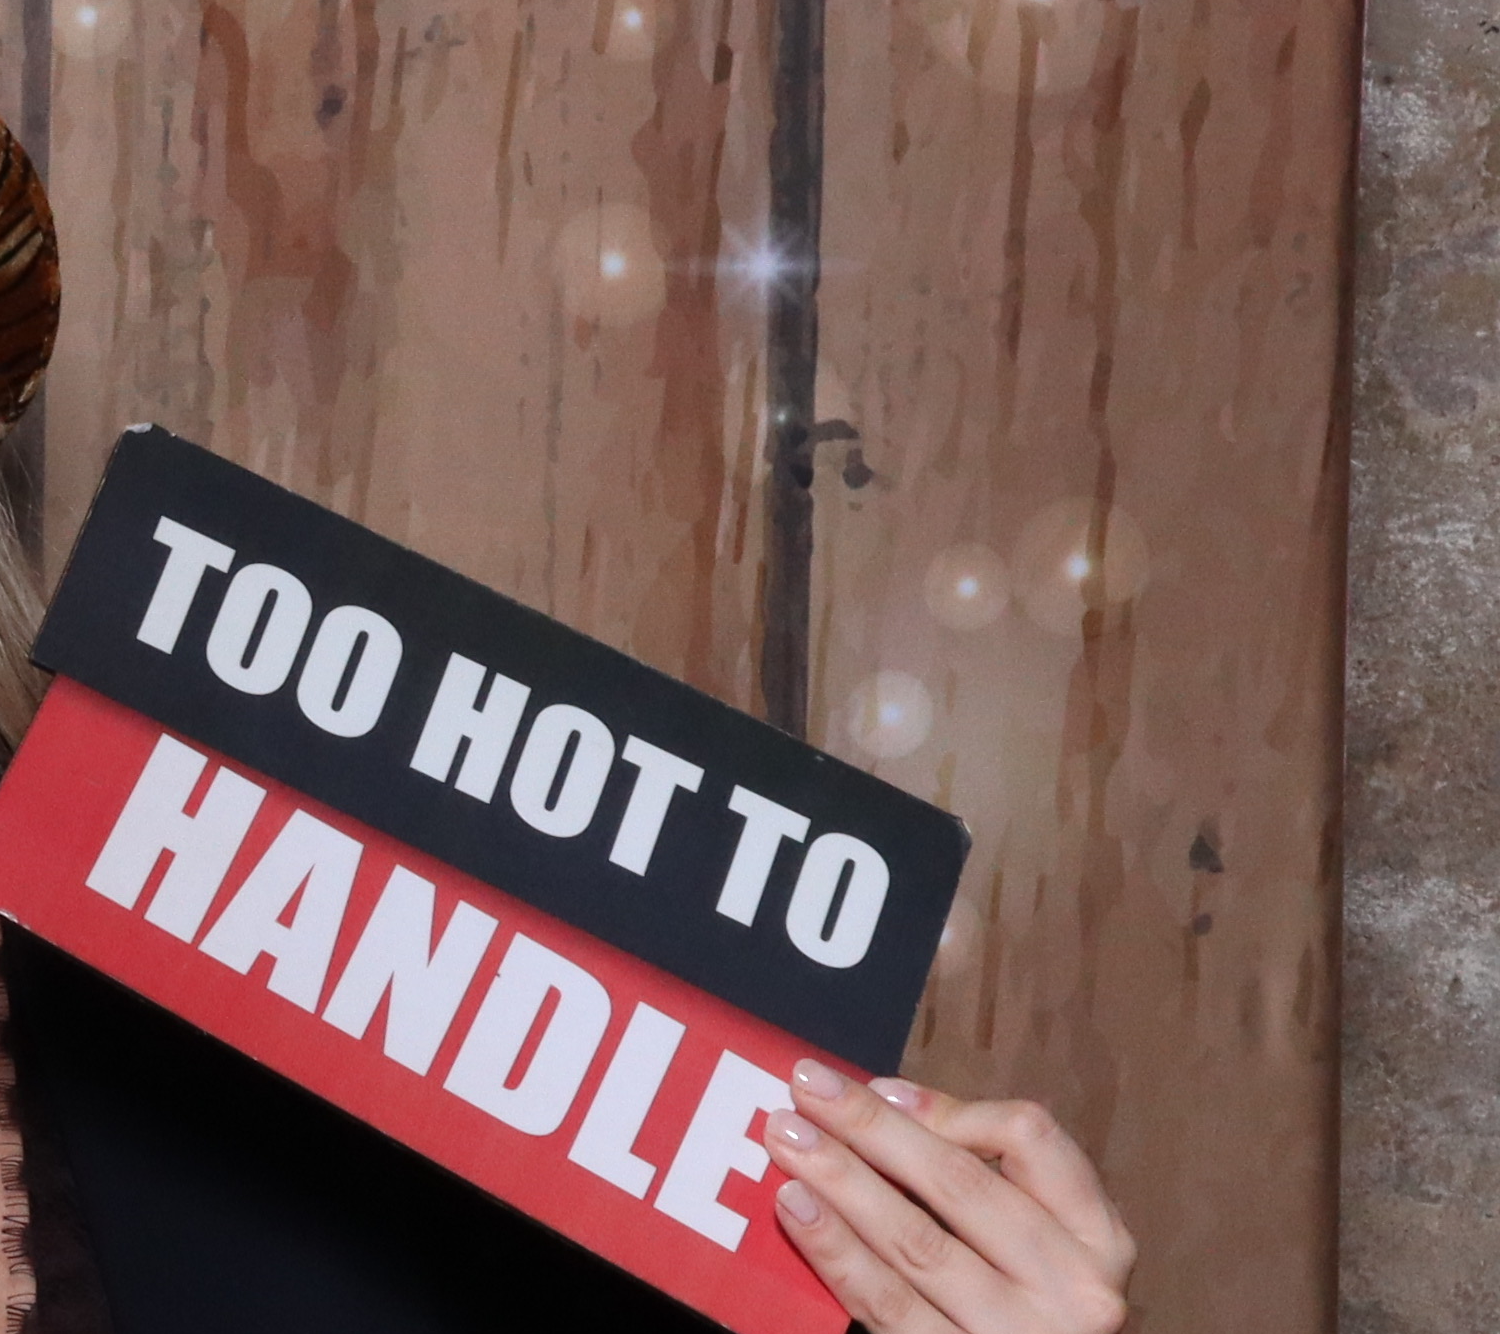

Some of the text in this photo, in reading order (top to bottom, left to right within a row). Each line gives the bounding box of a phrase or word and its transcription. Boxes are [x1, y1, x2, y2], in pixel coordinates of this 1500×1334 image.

[134, 514, 891, 970] TOO HOT TO
[84, 733, 796, 1253] HANDLE
